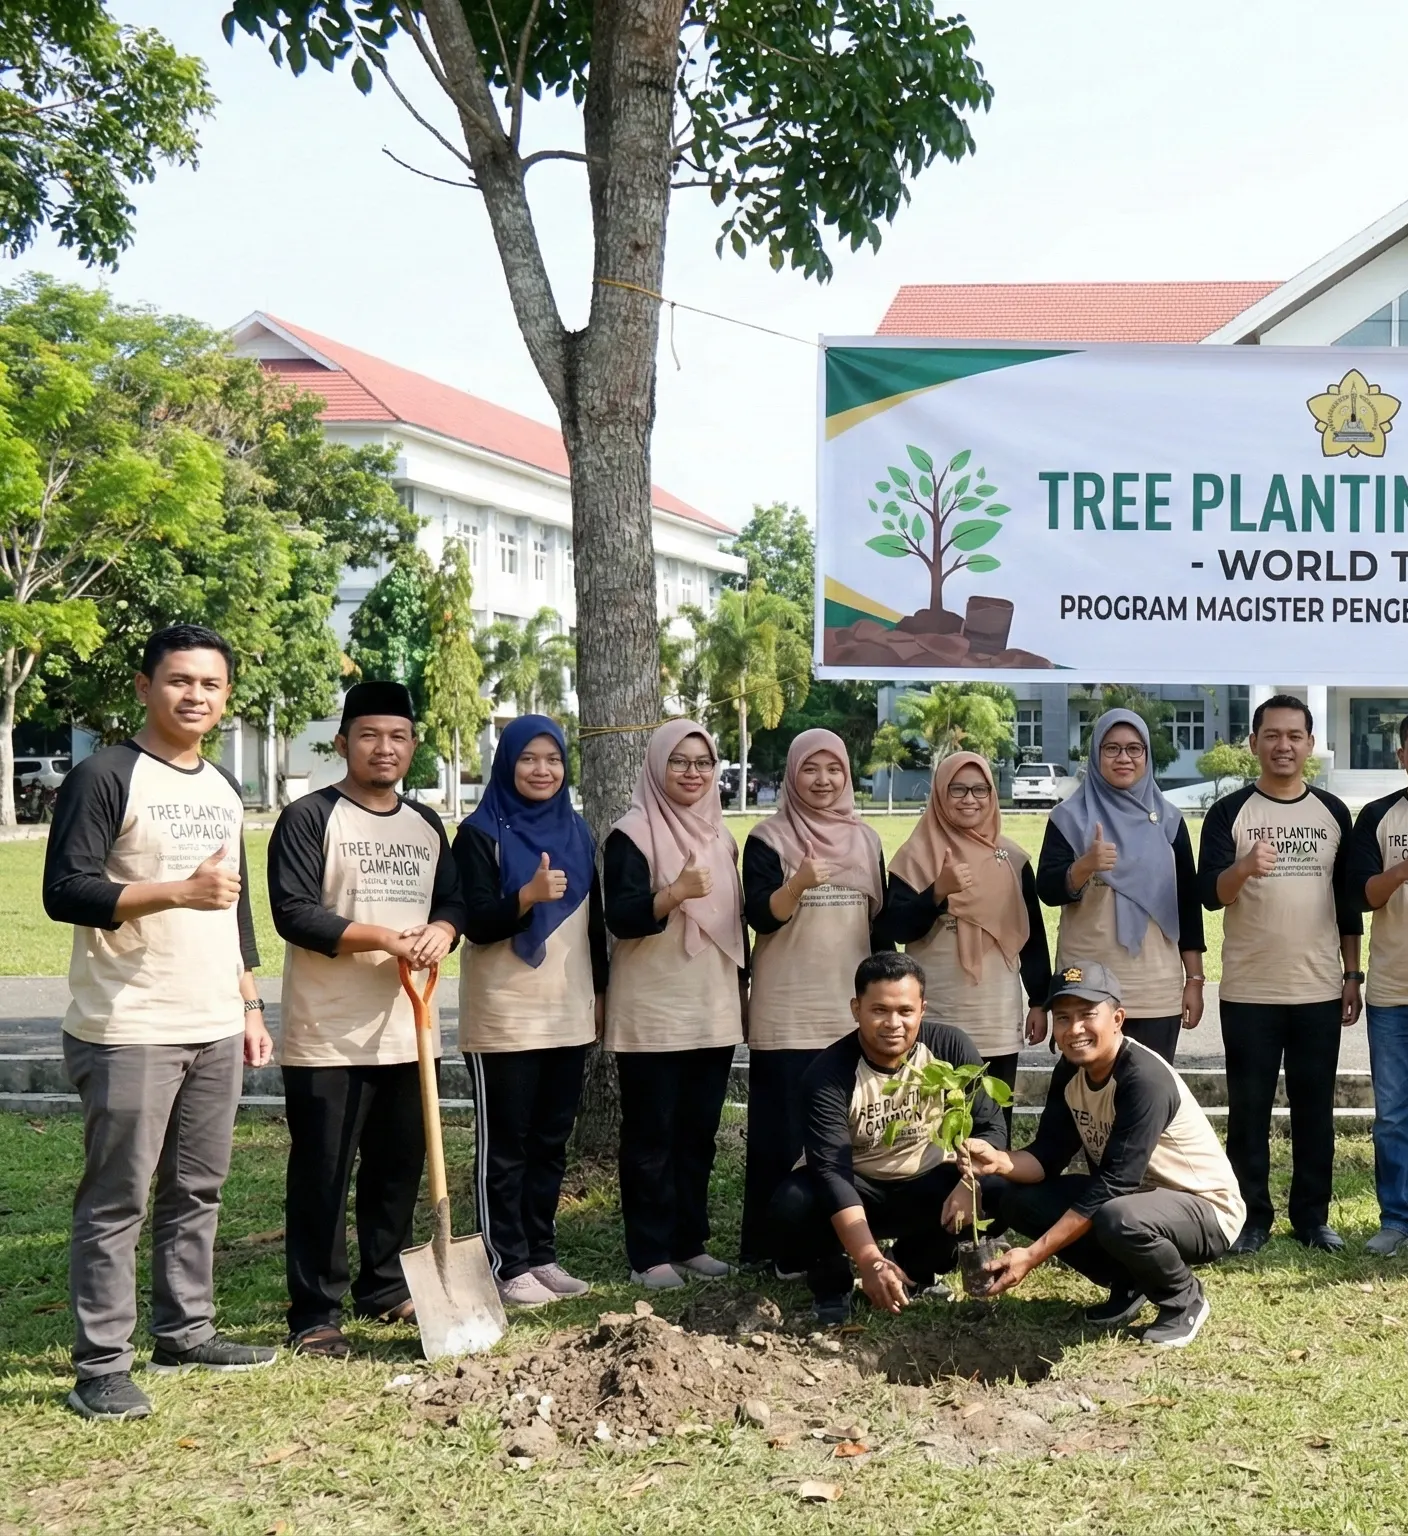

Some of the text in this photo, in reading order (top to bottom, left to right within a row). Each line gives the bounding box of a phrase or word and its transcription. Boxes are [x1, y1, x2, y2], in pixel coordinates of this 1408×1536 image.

[1039, 472, 1171, 531] TREE
[1218, 550, 1377, 581] WORLD
[1061, 595, 1187, 620] PROGRAM
[1197, 597, 1323, 622] MAGISTER
[148, 804, 182, 820] TREE
[1276, 826, 1328, 840] PLANTING
[340, 842, 430, 861] TREE PLANTING
